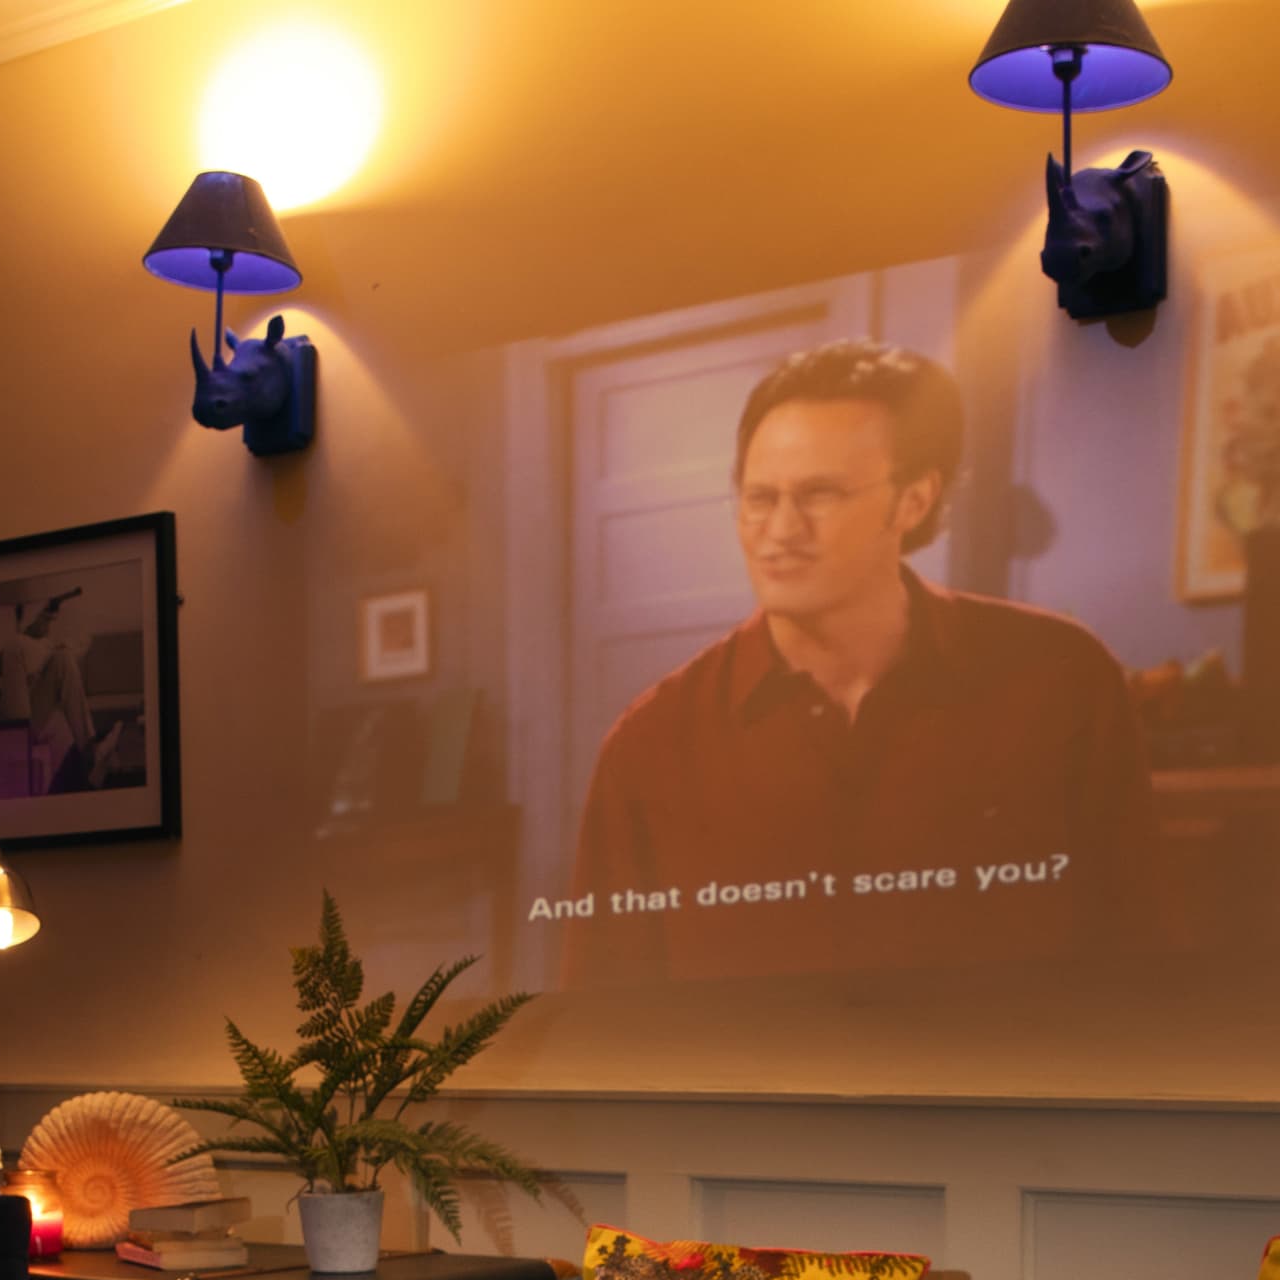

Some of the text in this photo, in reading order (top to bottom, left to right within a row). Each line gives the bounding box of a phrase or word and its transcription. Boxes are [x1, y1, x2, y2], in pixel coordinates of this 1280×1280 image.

[528, 853, 1069, 921] And that doesn't scare you?
